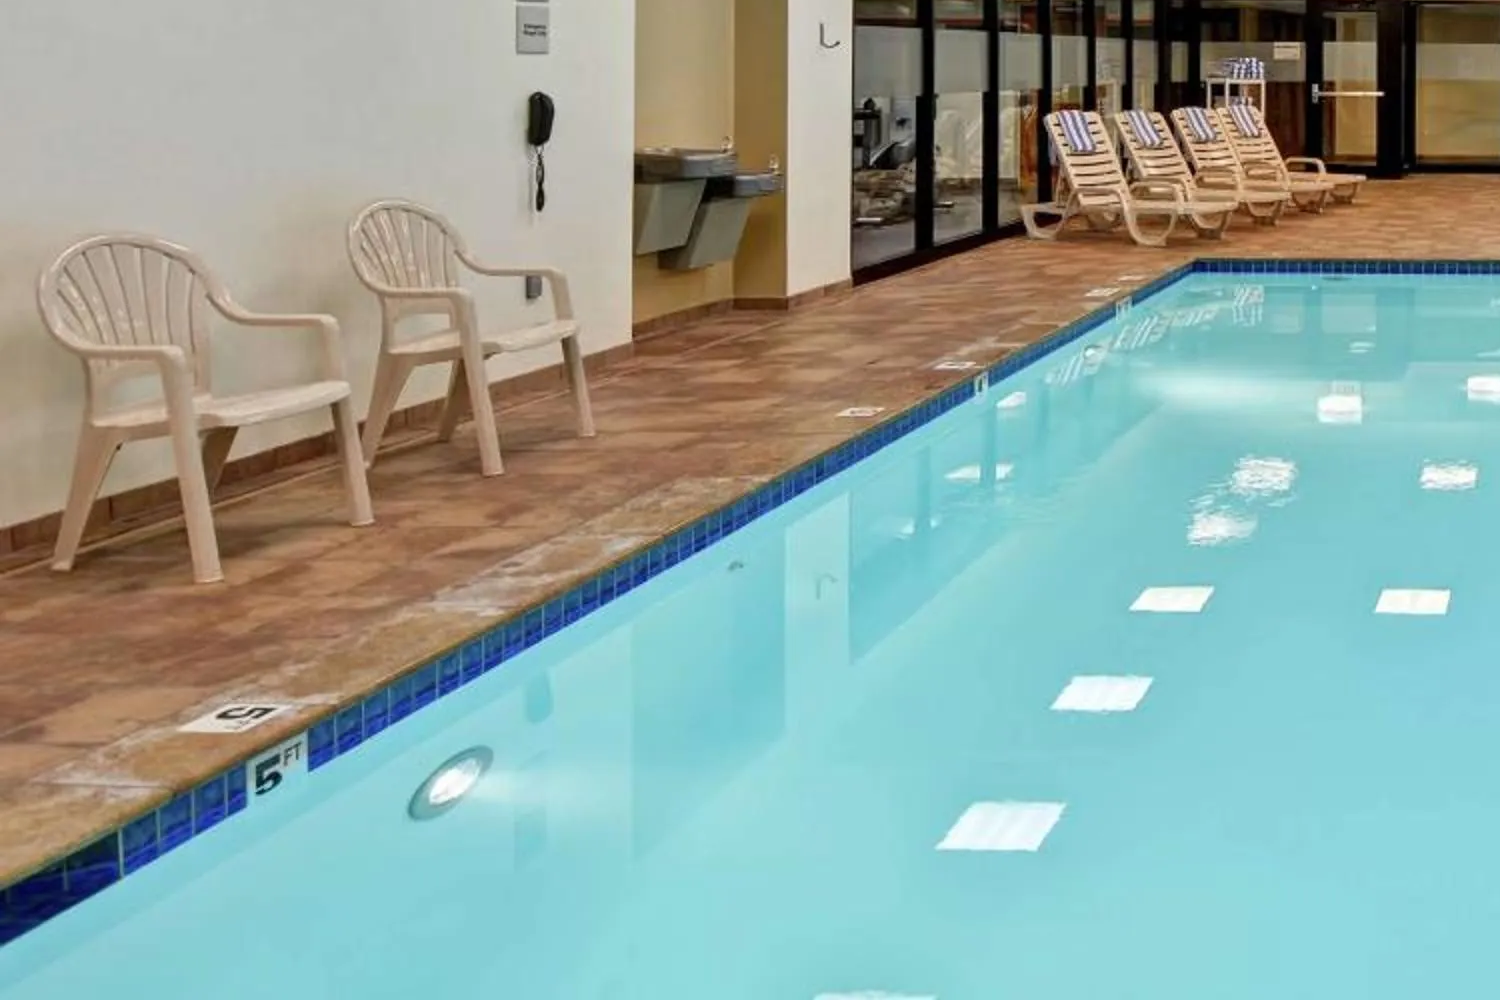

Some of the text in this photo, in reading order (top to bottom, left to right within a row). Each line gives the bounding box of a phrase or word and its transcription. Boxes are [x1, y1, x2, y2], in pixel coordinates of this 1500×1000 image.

[216, 707, 276, 719] 5
[255, 742, 302, 796] 5 FT
